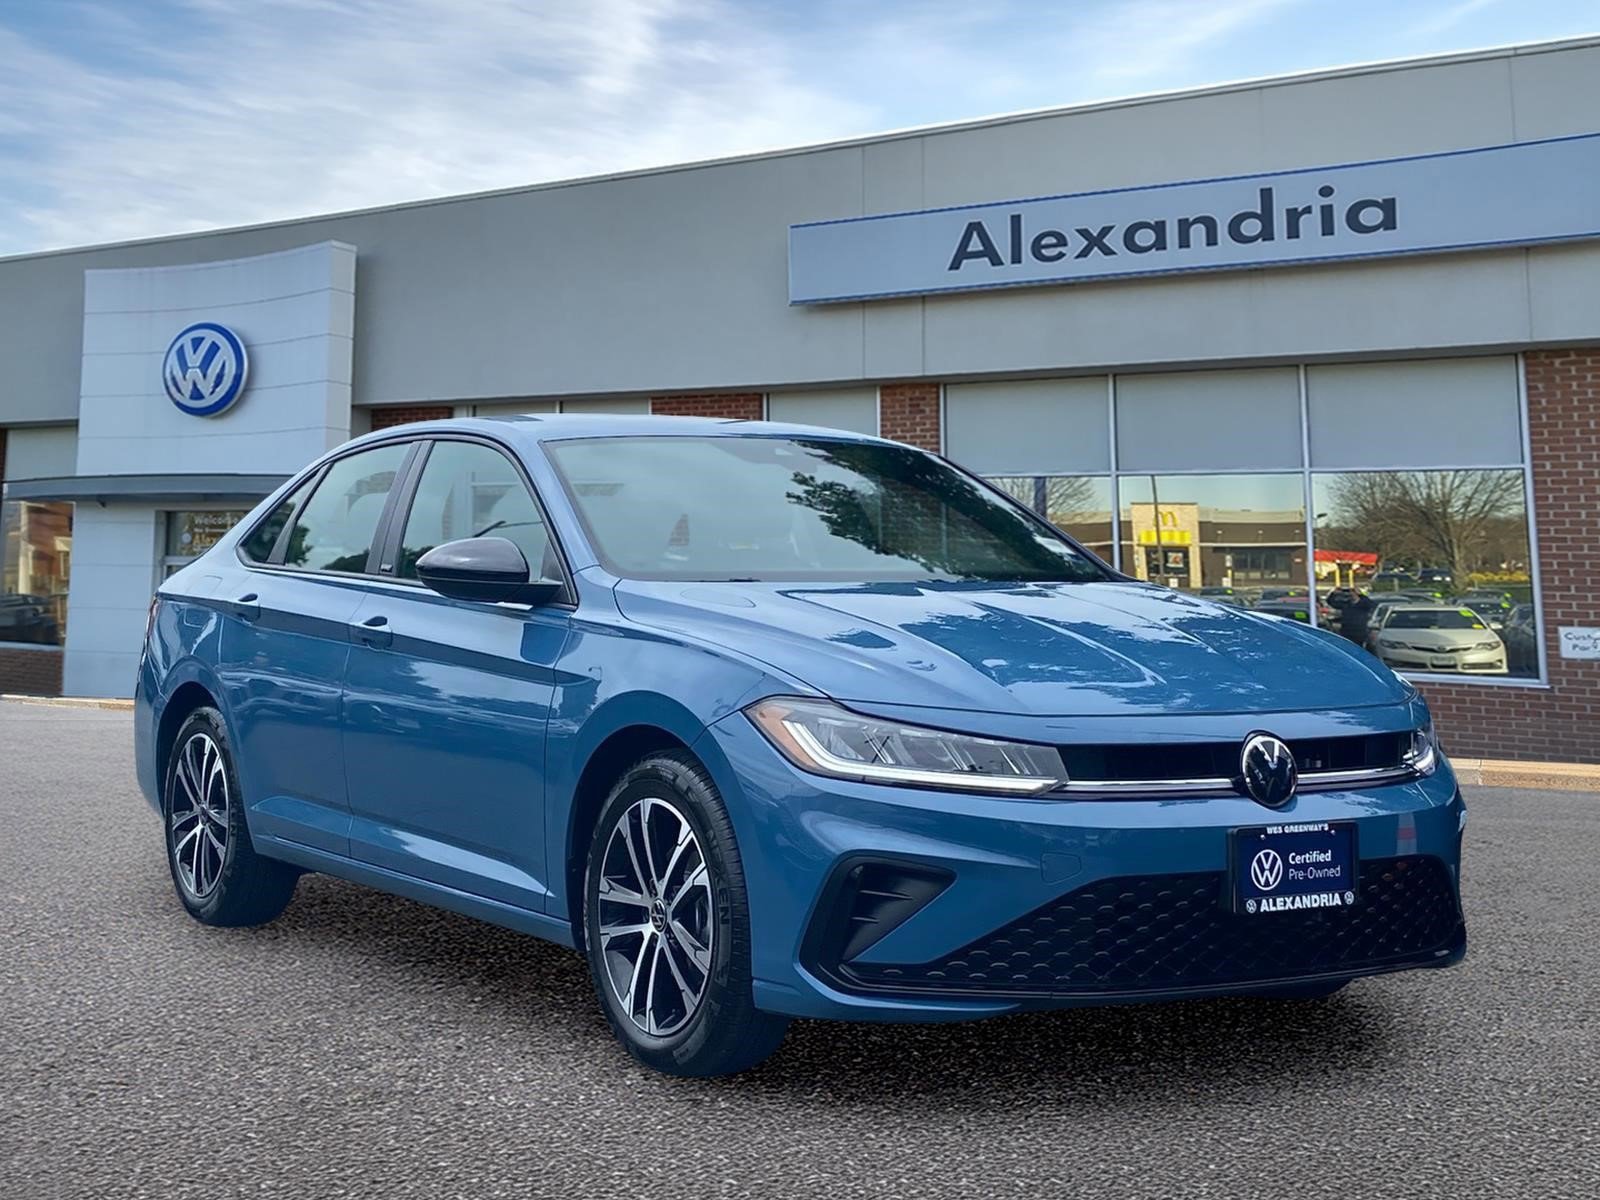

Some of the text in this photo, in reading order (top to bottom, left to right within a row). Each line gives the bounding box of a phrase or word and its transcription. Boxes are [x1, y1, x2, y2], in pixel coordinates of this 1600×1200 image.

[947, 185, 1397, 271] Alexandria
[1288, 850, 1332, 864] Certified
[1288, 865, 1341, 880] Pre-Owned
[1259, 893, 1342, 912] ALEXANDRIA
